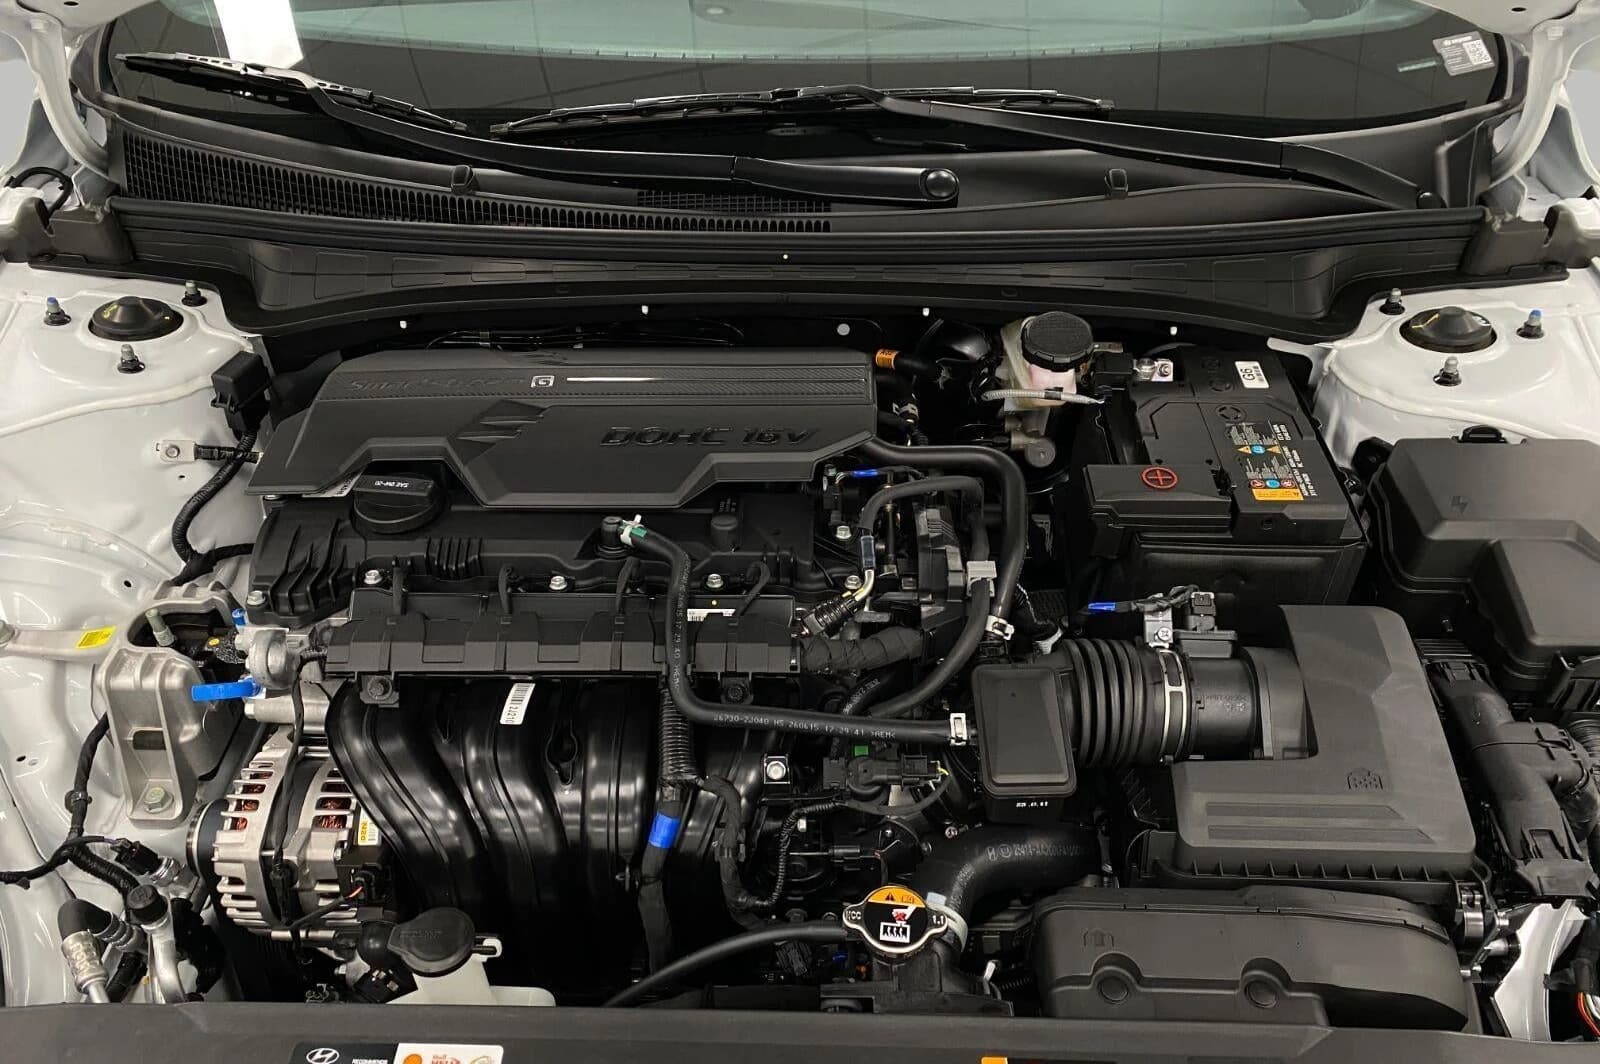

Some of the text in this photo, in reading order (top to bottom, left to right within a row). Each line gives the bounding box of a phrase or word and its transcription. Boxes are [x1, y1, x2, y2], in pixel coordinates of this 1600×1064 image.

[1240, 368, 1256, 380] G6
[600, 426, 815, 446] DOHC 16V
[932, 915, 945, 925] 1.1
